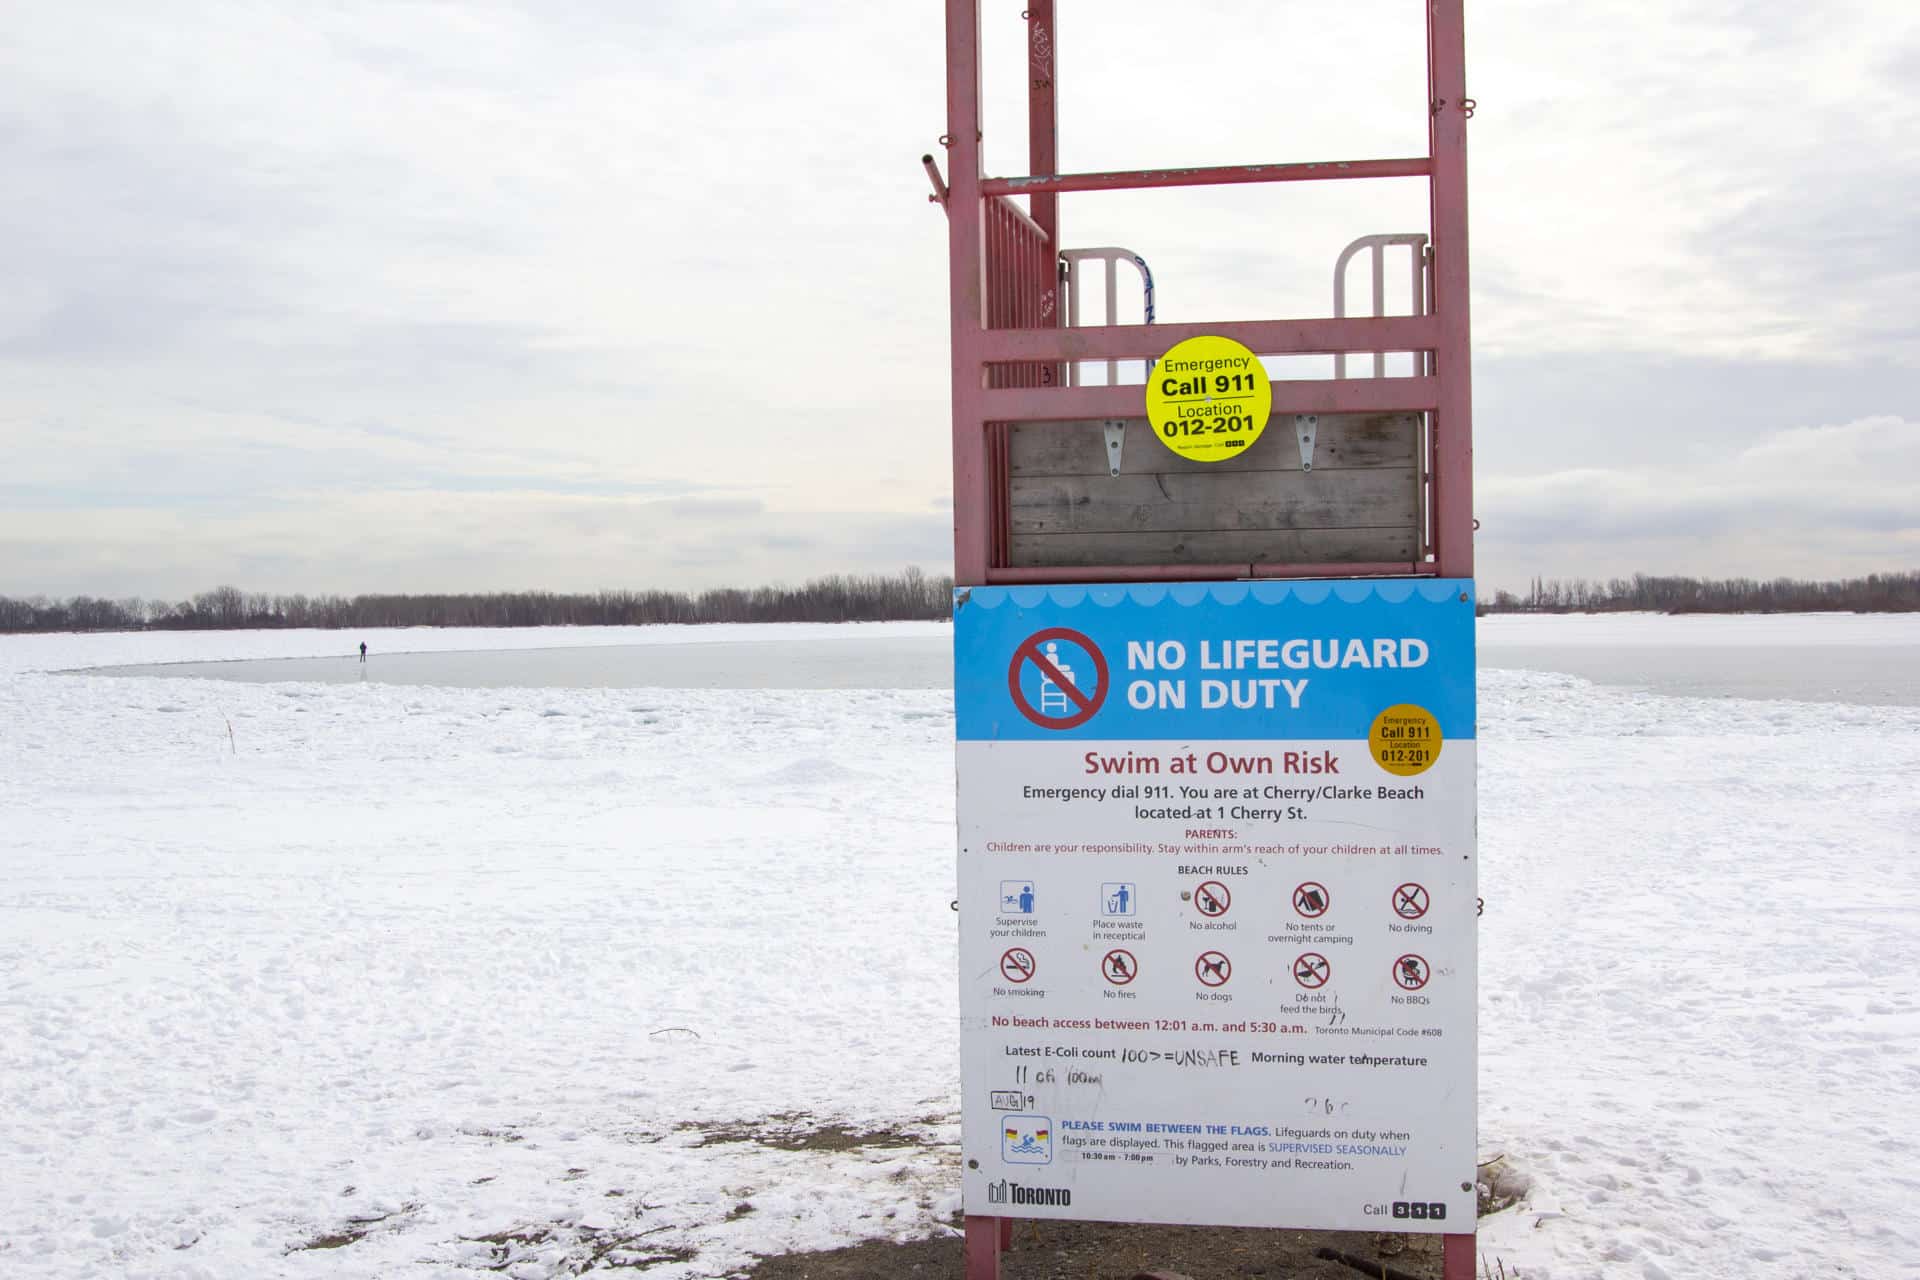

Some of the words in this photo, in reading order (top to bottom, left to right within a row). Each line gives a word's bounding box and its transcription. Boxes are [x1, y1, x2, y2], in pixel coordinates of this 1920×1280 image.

[1164, 357, 1250, 372] Emergency
[1162, 376, 1206, 396] Call
[1215, 373, 1254, 393] 911
[1178, 402, 1242, 418] Location
[1163, 414, 1254, 438] 012-201
[1126, 640, 1186, 670] NO
[1200, 638, 1430, 670] LIFEGUARD
[1126, 679, 1186, 710] ON
[1200, 679, 1309, 709] DUTY
[1383, 716, 1426, 726] Emergency
[1382, 726, 1404, 738] Call
[1408, 726, 1429, 738] 911
[1084, 751, 1160, 774] Swim
[1169, 754, 1198, 774] at
[1206, 751, 1273, 774] Own
[1284, 750, 1340, 774] Risk
[1382, 750, 1429, 762] 012-201
[1023, 786, 1106, 802] Emergency
[1111, 785, 1139, 799] dial
[1144, 786, 1174, 799] 911.
[1179, 786, 1208, 799] You
[1213, 788, 1238, 799] are
[1243, 787, 1258, 799] at
[1263, 786, 1372, 802] Cherry/Clarke
[1378, 786, 1424, 800] Beach
[1135, 805, 1191, 819] located
[1196, 808, 1212, 819] at
[1218, 806, 1224, 819] 1
[1231, 806, 1282, 822] Cherry
[1287, 806, 1308, 820] St.
[1185, 829, 1238, 839] PARENTS:
[986, 842, 1031, 852] Children
[1034, 844, 1051, 852] are
[1054, 844, 1080, 855] your
[1082, 842, 1154, 855] responsibility.
[1158, 843, 1181, 856] Stay
[1183, 843, 1220, 854] within
[1222, 844, 1252, 854] arm's
[1255, 844, 1285, 854] reach
[1288, 844, 1299, 854] of
[1303, 846, 1327, 856] your
[1331, 844, 1377, 855] children
[1379, 846, 1391, 855] at
[1394, 845, 1407, 855] all
[1410, 846, 1444, 856] times.
[1178, 866, 1213, 875] BEACH
[1216, 866, 1249, 875] RULES
[995, 917, 1038, 927] Supervise
[1092, 920, 1116, 929] Place
[1117, 920, 1144, 929] waste
[1189, 921, 1203, 930] No
[1204, 921, 1237, 930] alcohol
[1285, 922, 1298, 932] No
[1300, 922, 1324, 932] tents
[1325, 924, 1336, 932] or
[990, 930, 1009, 939] your
[1011, 928, 1046, 937] children
[1388, 924, 1402, 933] No
[1403, 924, 1433, 935] diving
[1092, 931, 1101, 940] in
[1103, 931, 1146, 942] receptical
[1267, 934, 1311, 944] overnight
[1313, 935, 1354, 945] camping
[993, 987, 1006, 996] No
[1007, 987, 1045, 998] smoking
[1103, 990, 1116, 999] No
[1118, 989, 1136, 999] fires
[1196, 992, 1208, 1000] No
[1210, 992, 1233, 1003] dogs
[1296, 993, 1308, 1003] Do
[1310, 993, 1326, 1003] not
[1391, 996, 1404, 1004] No
[1280, 1004, 1300, 1014] feed
[1302, 1005, 1318, 1014] the
[1319, 1005, 1342, 1015] birds
[992, 1016, 1009, 1027] No
[1013, 1016, 1049, 1028] beach
[1052, 1018, 1090, 1029] access
[1095, 1018, 1150, 1030] between
[1154, 1020, 1186, 1031] 12:01
[1191, 1022, 1218, 1032] a.m.
[1222, 1021, 1246, 1032] and
[1250, 1022, 1276, 1033] 5:30
[1280, 1024, 1308, 1034] a.m.
[1315, 1026, 1349, 1036] Toronto
[1351, 1027, 1394, 1037] Municipal
[1396, 1028, 1419, 1036] Code
[1421, 1028, 1442, 1037] #608
[1005, 1045, 1041, 1057] Latest
[1045, 1046, 1078, 1058] E-Coli
[1082, 1047, 1116, 1058] count
[1251, 1052, 1305, 1066] Morning
[1308, 1054, 1346, 1065] water
[1349, 1054, 1428, 1068] temperature
[1061, 1120, 1104, 1131] PLEASE
[1108, 1122, 1142, 1132] SWIM
[1146, 1122, 1201, 1134] BETWEEN
[1206, 1125, 1227, 1135] THE
[1231, 1126, 1271, 1136] FLAGS.
[1275, 1127, 1331, 1139] Lifeguards
[1334, 1131, 1348, 1139] on
[1351, 1129, 1376, 1142] duty
[1380, 1130, 1410, 1141] when
[1062, 1135, 1087, 1147] flags
[1089, 1137, 1106, 1146] are
[1109, 1137, 1160, 1150] displayed.
[1164, 1139, 1185, 1150] This
[1188, 1139, 1228, 1151] flagged
[1232, 1143, 1254, 1152] area
[1258, 1142, 1266, 1152] is
[1268, 1142, 1333, 1154] SUPERVISED
[1336, 1145, 1407, 1156] SEASONALLY
[1175, 1154, 1188, 1167] by
[1192, 1155, 1222, 1167] Parks,
[1225, 1156, 1268, 1169] Forestry
[1271, 1158, 1291, 1168] and
[1295, 1159, 1354, 1170] Recreation.
[1008, 1183, 1071, 1206] TORONTO
[1363, 1204, 1388, 1216] Call
[1394, 1204, 1444, 1218] 311
